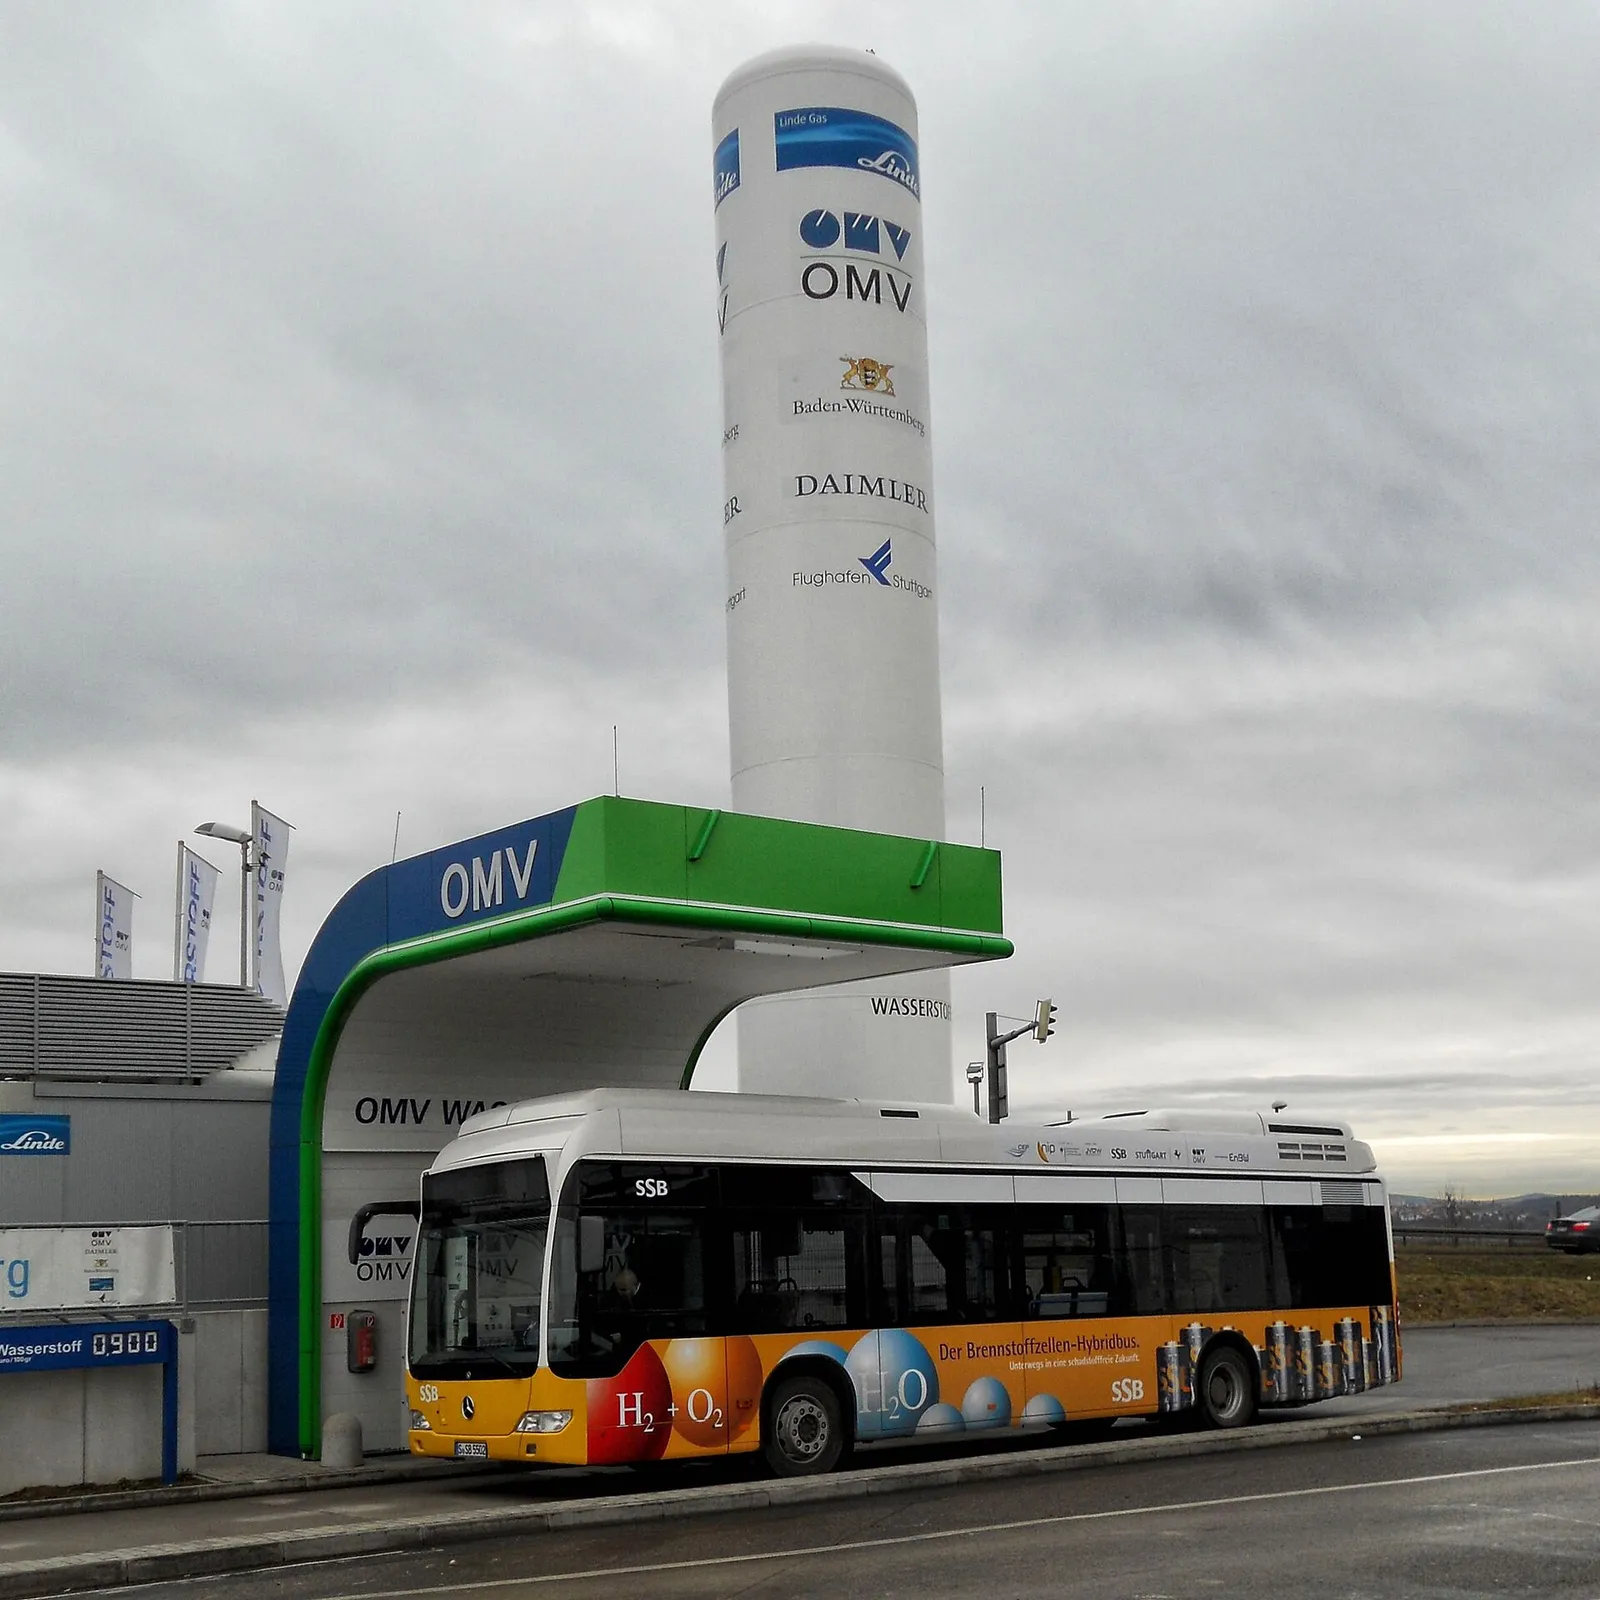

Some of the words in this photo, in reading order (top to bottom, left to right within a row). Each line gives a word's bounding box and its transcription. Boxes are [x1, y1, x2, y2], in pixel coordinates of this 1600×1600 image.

[780, 114, 806, 127] Linde
[809, 113, 827, 125] Gas
[801, 262, 912, 313] OMV
[793, 398, 926, 438] Baden-Württemberg
[794, 473, 929, 514] DAIMLER
[793, 569, 871, 588] Flughafen
[440, 839, 538, 918] OMV
[355, 1097, 431, 1125] OMV
[0, 1130, 65, 1150] Linde
[1111, 1148, 1127, 1159] SSB
[635, 1178, 668, 1198] SSB
[91, 1239, 112, 1247] OMV
[356, 1261, 412, 1281] OMV
[939, 1343, 963, 1361] Der
[967, 1334, 1140, 1359] Brennstoffzellen-Hybridbus.
[1009, 1359, 1044, 1371] Unterwegs
[1045, 1358, 1052, 1368] in
[1053, 1358, 1067, 1368] eine
[1115, 1353, 1140, 1364] Zukunft.
[420, 1384, 439, 1403] SSB
[1111, 1377, 1144, 1402] SSB
